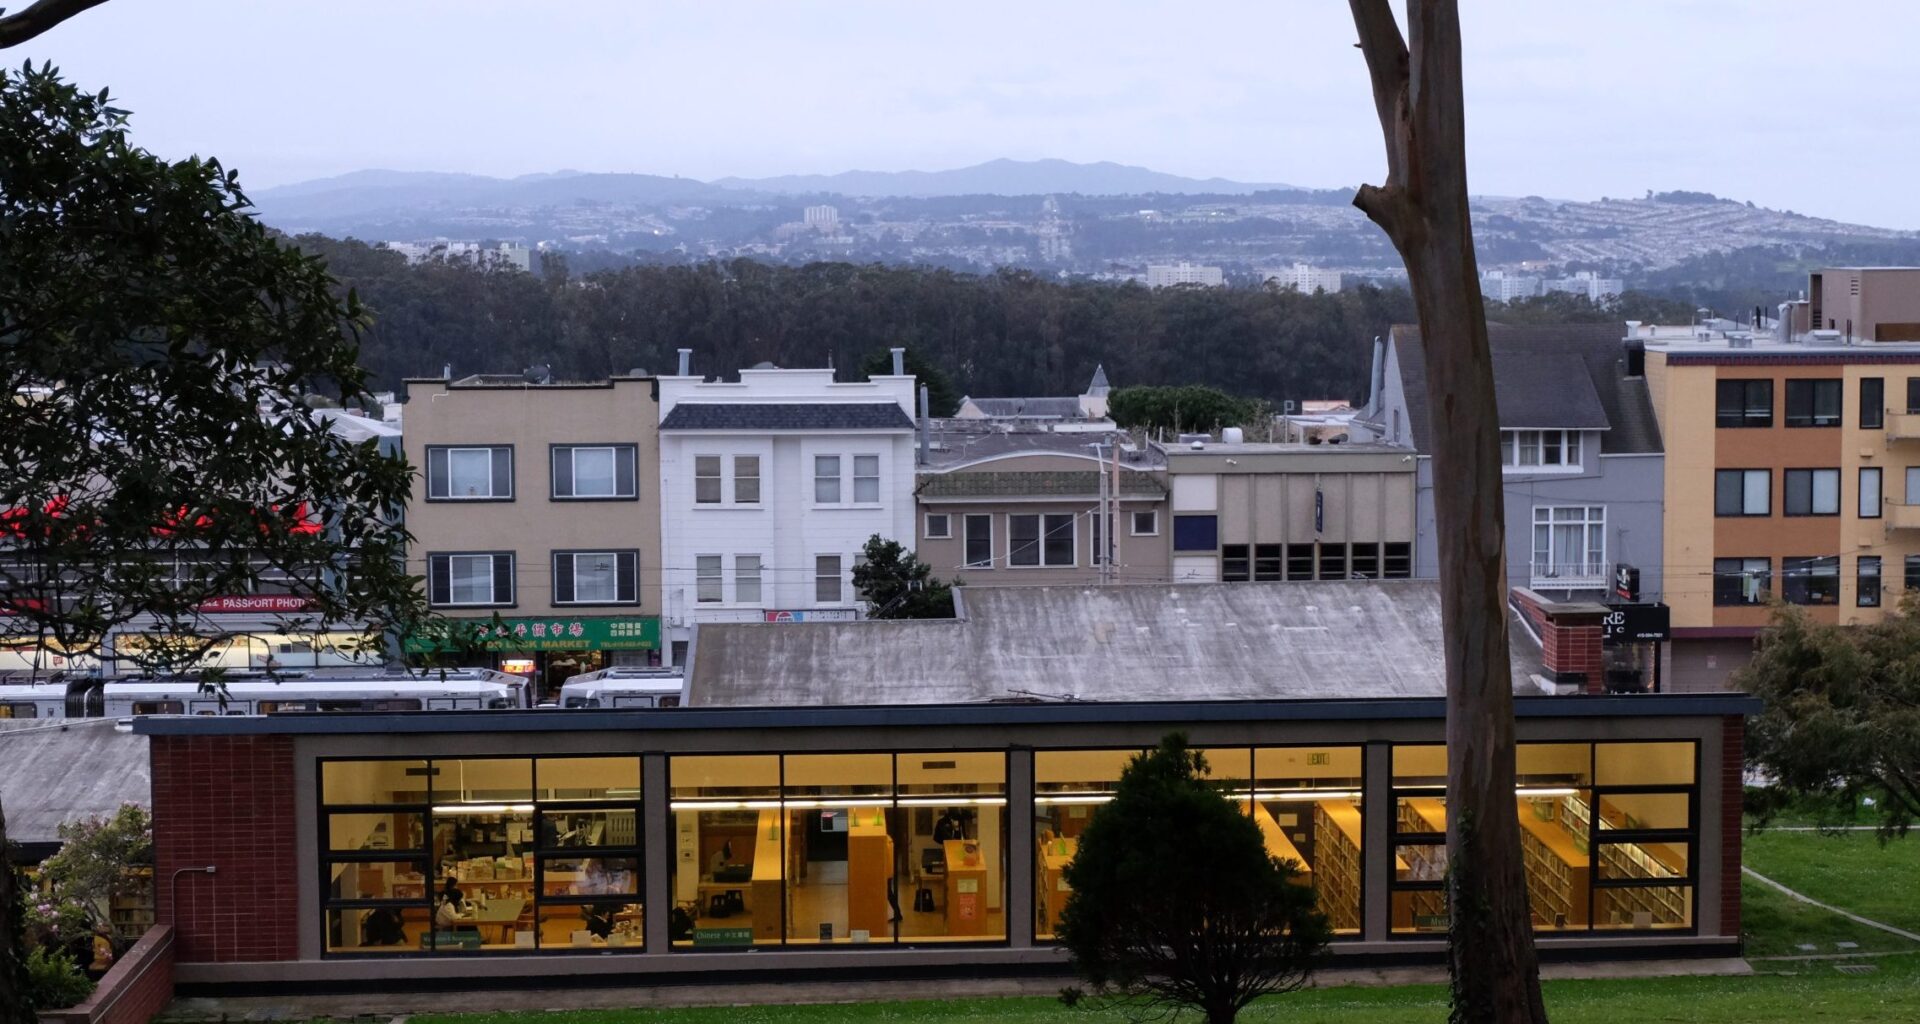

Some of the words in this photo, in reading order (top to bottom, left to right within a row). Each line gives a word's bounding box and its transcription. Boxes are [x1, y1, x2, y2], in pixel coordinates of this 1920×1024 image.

[223, 598, 274, 608] PASSPORT
[276, 598, 315, 607] PHOT
[1603, 611, 1625, 625] RE
[542, 640, 592, 649] MARKET
